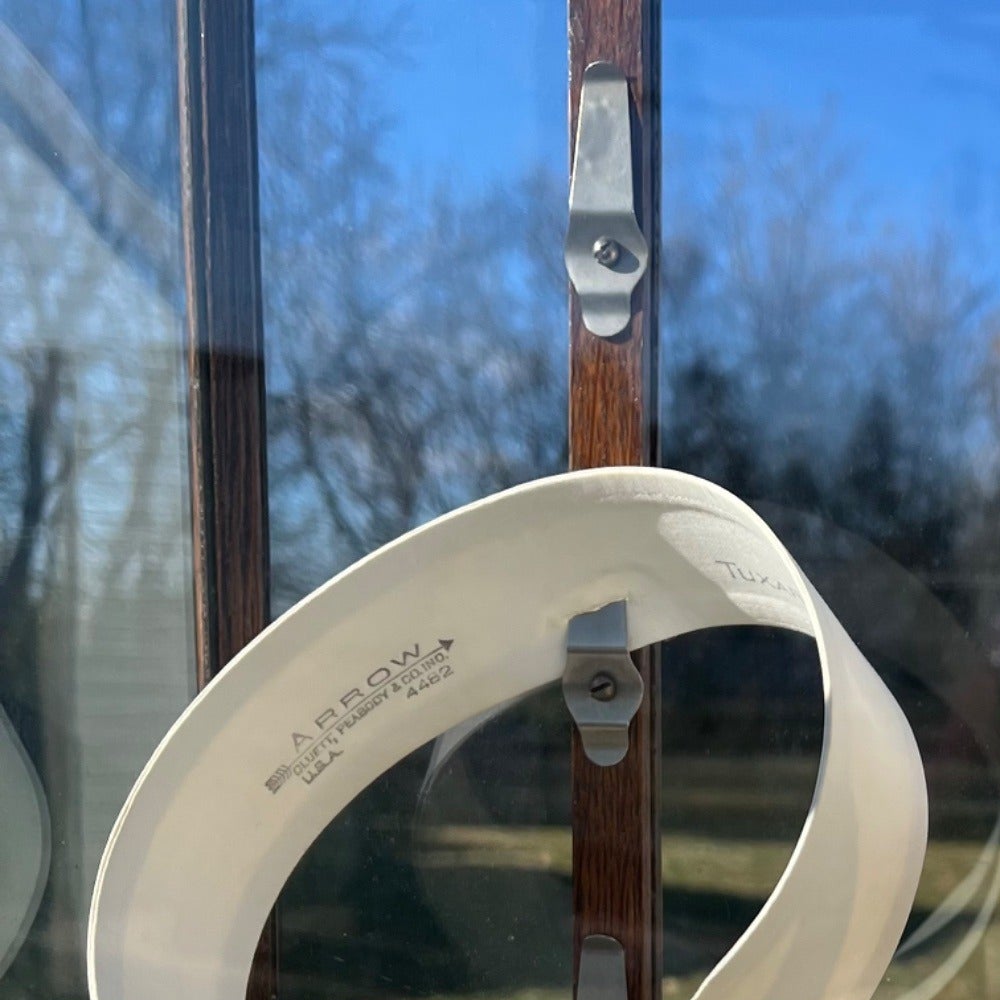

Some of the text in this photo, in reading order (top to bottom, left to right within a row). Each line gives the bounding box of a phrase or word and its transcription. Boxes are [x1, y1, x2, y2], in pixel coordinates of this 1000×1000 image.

[292, 643, 420, 753] ARROW
[336, 688, 389, 735] PEABODY
[391, 682, 402, 693] &
